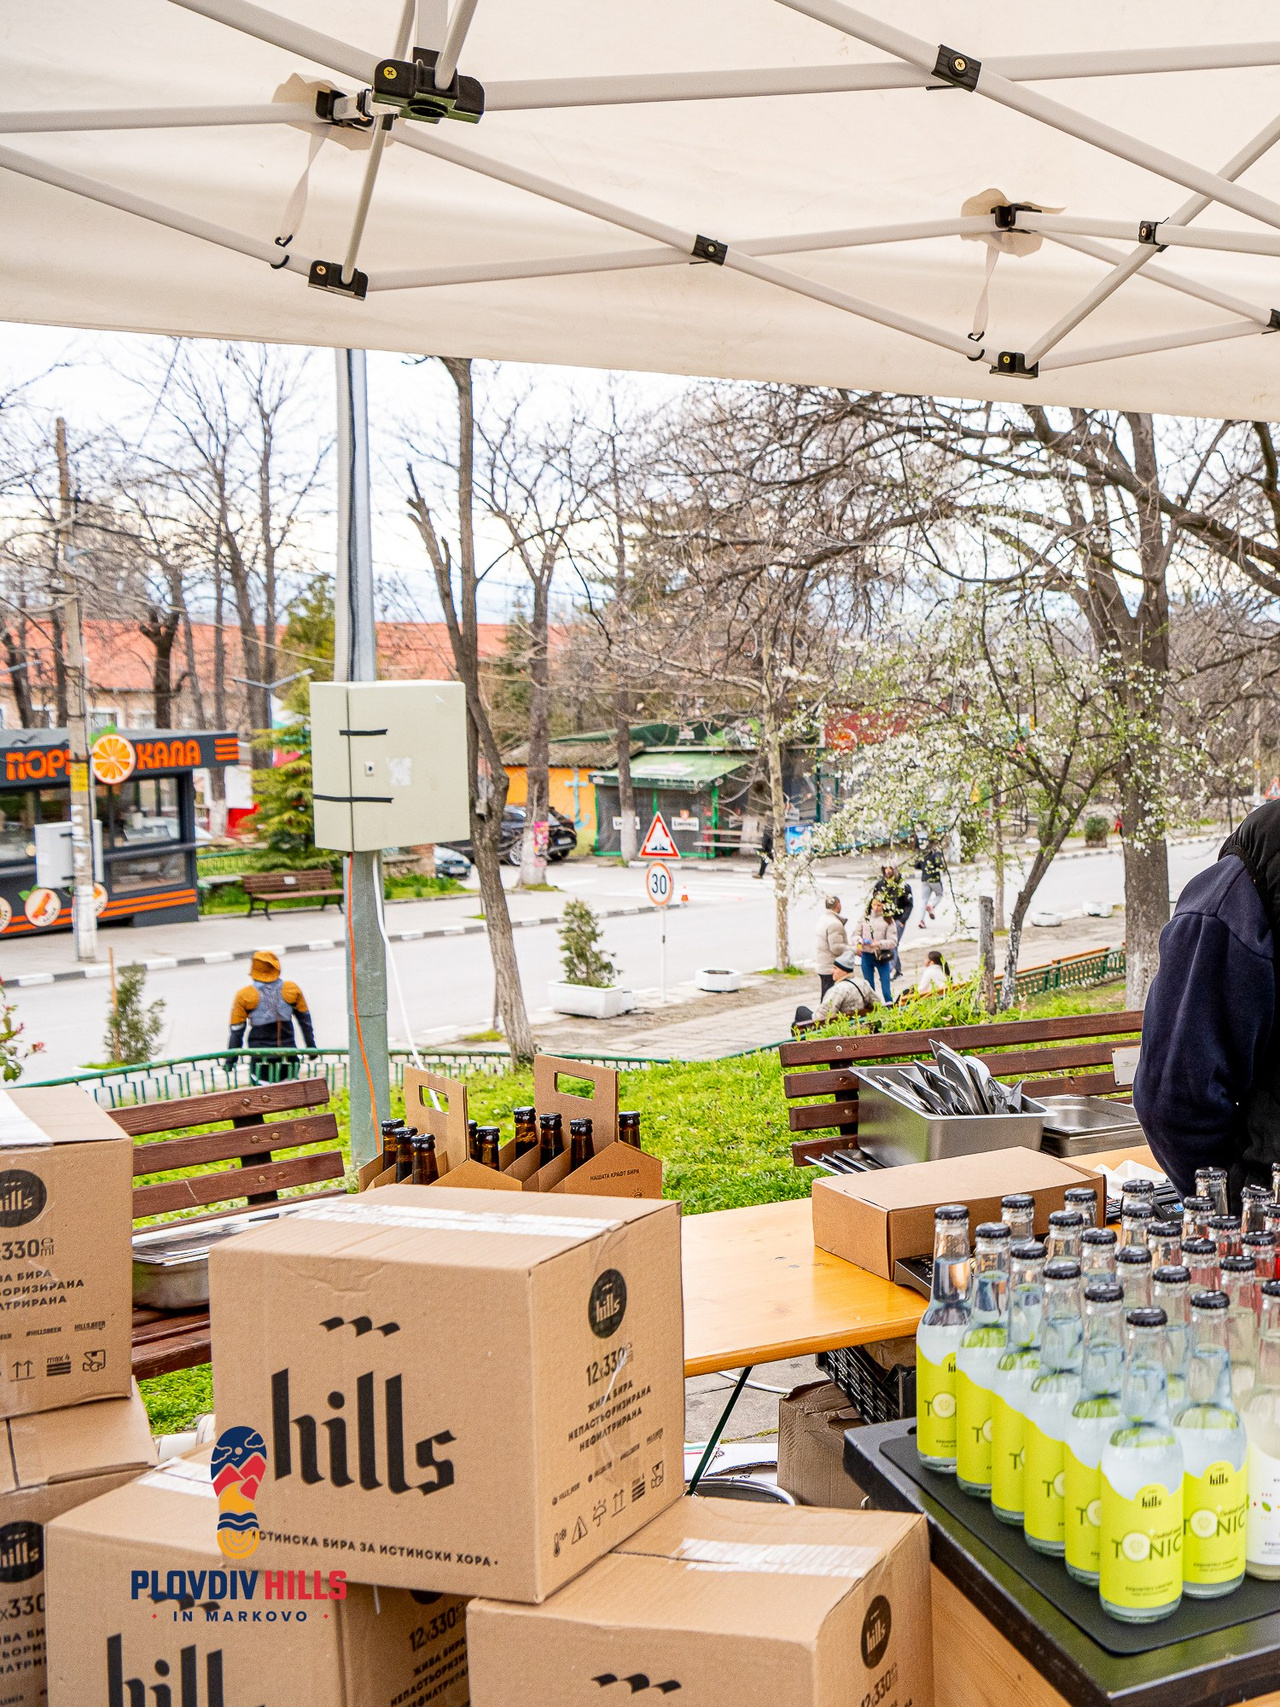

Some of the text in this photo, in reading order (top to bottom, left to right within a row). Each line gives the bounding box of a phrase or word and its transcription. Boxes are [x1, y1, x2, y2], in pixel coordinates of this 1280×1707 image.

[651, 873, 667, 895] 30
[0, 1239, 40, 1260] 330
[17, 1270, 51, 1281] БИРА
[597, 1293, 620, 1323] hills
[613, 1380, 633, 1398] БИРА
[271, 1367, 457, 1497] hills
[1209, 1473, 1229, 1485] hills
[1141, 1496, 1162, 1508] hills
[323, 1538, 356, 1552] БИРА
[359, 1543, 376, 1553] ЗА
[380, 1545, 451, 1562] ИСТИНСКИ
[456, 1553, 491, 1567] ХОРА
[409, 1608, 456, 1653] 12x330
[866, 1620, 886, 1655] hills
[106, 1633, 226, 1707] hill
[413, 1638, 466, 1678] ЖИВА БИРА
[391, 1651, 468, 1707] НЕПАСТЬОРИЗИ
